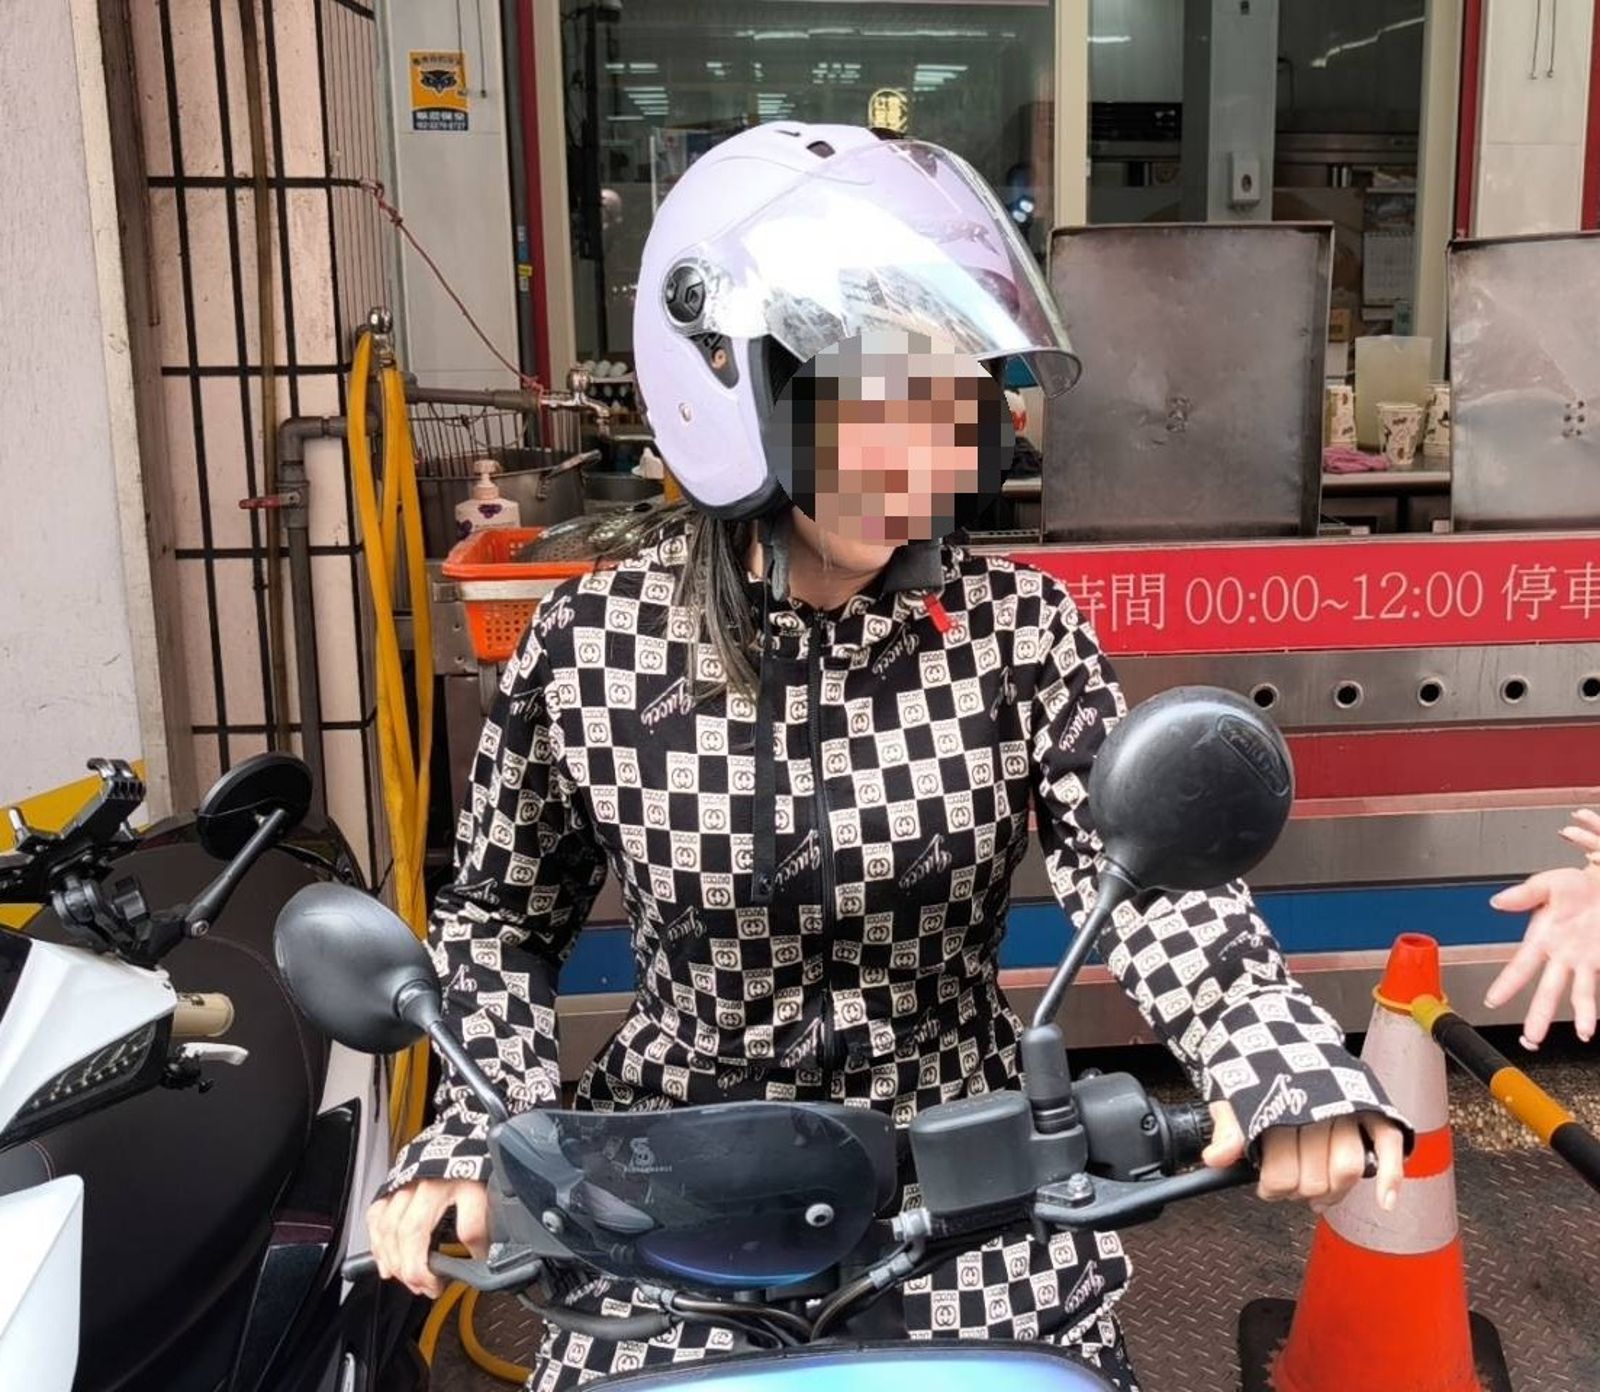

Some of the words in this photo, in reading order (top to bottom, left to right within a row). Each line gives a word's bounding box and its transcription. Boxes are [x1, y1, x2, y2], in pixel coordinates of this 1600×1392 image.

[1185, 570, 1483, 625] 00:00~12:00
[1500, 561, 1600, 621] 停車
[873, 622, 920, 681] Gucci
[640, 676, 694, 735] Gucci
[1060, 697, 1099, 753] Gucci
[774, 829, 821, 892] Gucci
[899, 834, 953, 896] Gucci
